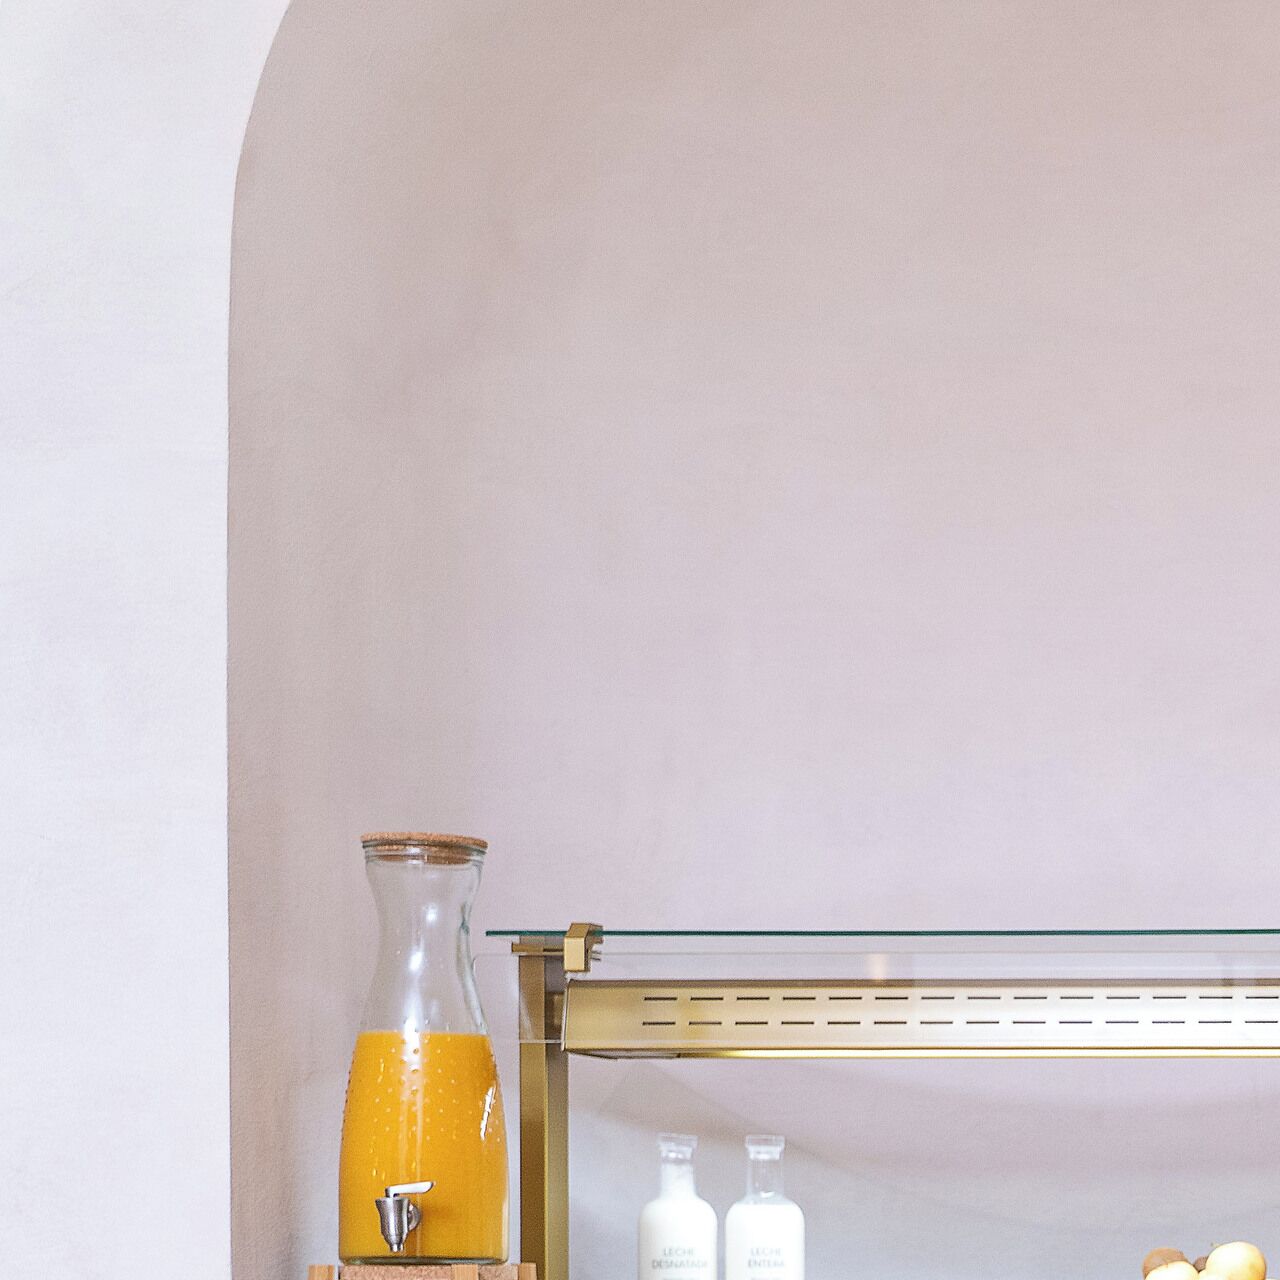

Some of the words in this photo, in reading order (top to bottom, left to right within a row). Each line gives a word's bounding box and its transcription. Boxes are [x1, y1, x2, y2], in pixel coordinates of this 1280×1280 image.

[663, 1247, 696, 1257] LECHE
[750, 1247, 783, 1257] LECHE
[651, 1259, 709, 1269] DESNATADA
[747, 1258, 785, 1268] ENTERA
